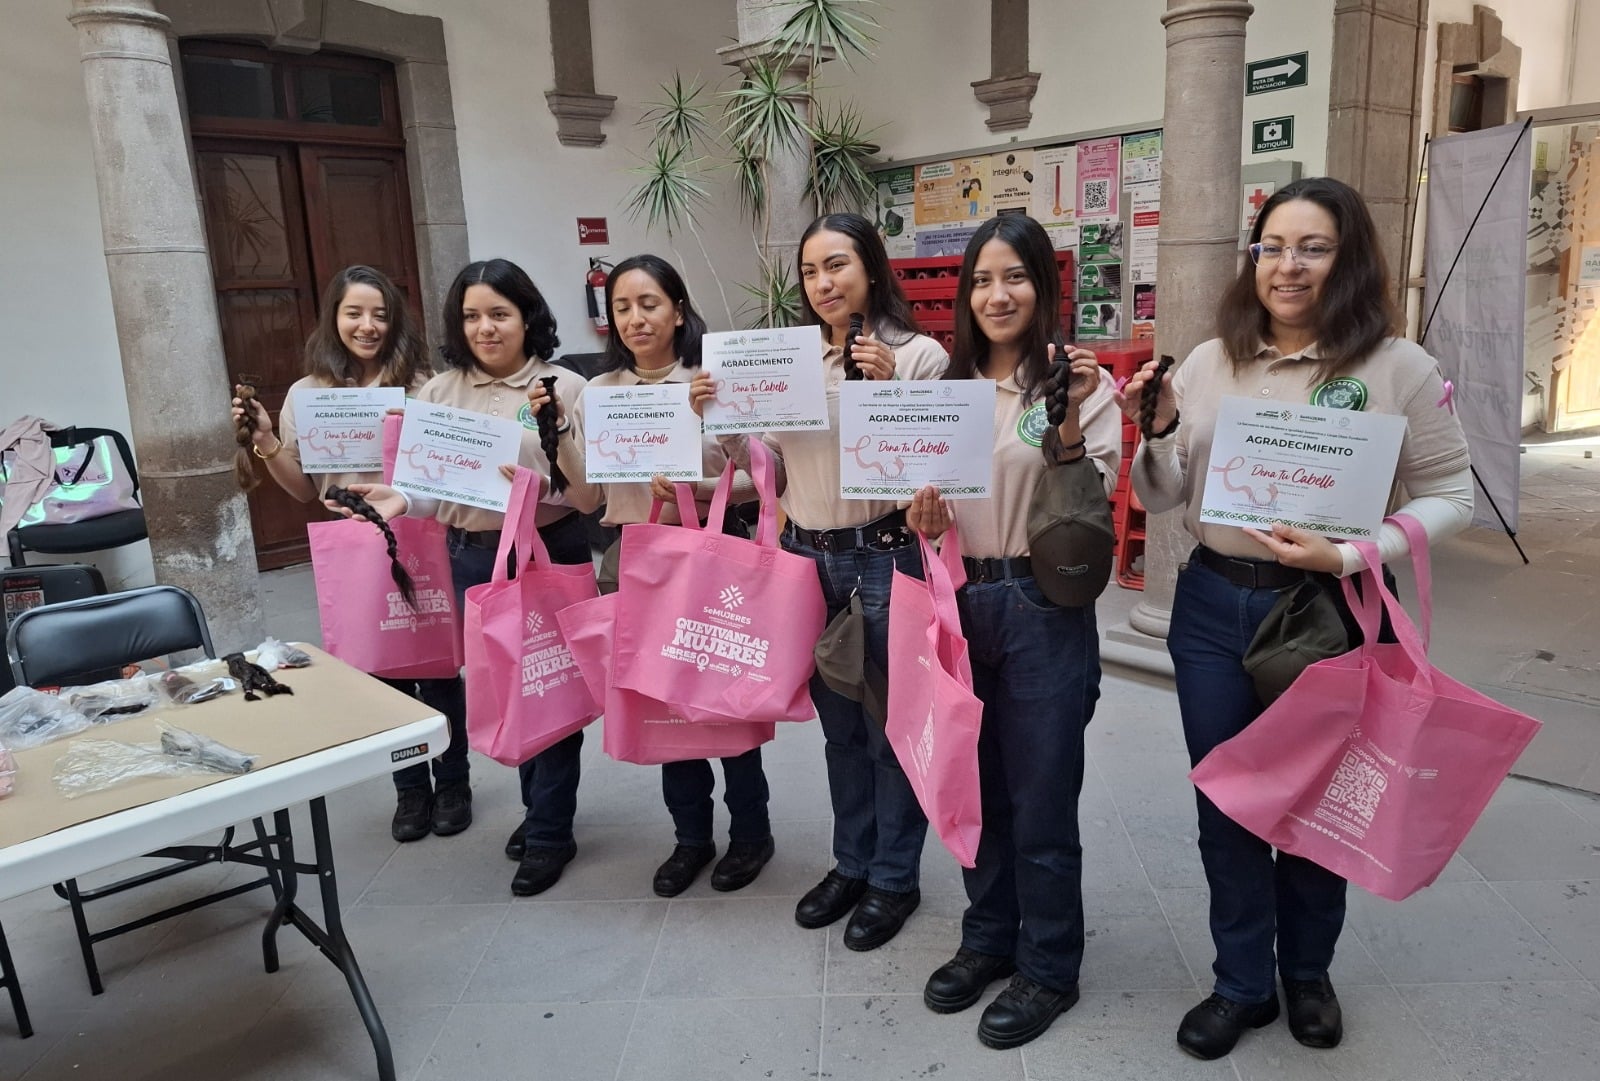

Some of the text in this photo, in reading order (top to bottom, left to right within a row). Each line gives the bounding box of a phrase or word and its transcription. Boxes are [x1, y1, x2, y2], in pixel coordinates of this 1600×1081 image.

[1257, 139, 1288, 149] BOTIQUÍN
[721, 357, 793, 368] AGRADECIMIENTO
[315, 411, 379, 419] AGRADECIMIENTO
[607, 411, 675, 420] AGRADECIMIENTO
[868, 414, 960, 423] AGRADECIMIENTO
[424, 429, 492, 448] AGRADECIMIENTO
[878, 440, 901, 453] Dona
[912, 438, 950, 455] Cabello
[1246, 435, 1353, 457] AGRADECIMIENTO
[1251, 464, 1277, 478] Dona
[1291, 468, 1335, 489] Cabello
[703, 606, 752, 625] SeMUJERES
[672, 628, 768, 668] MUJERES
